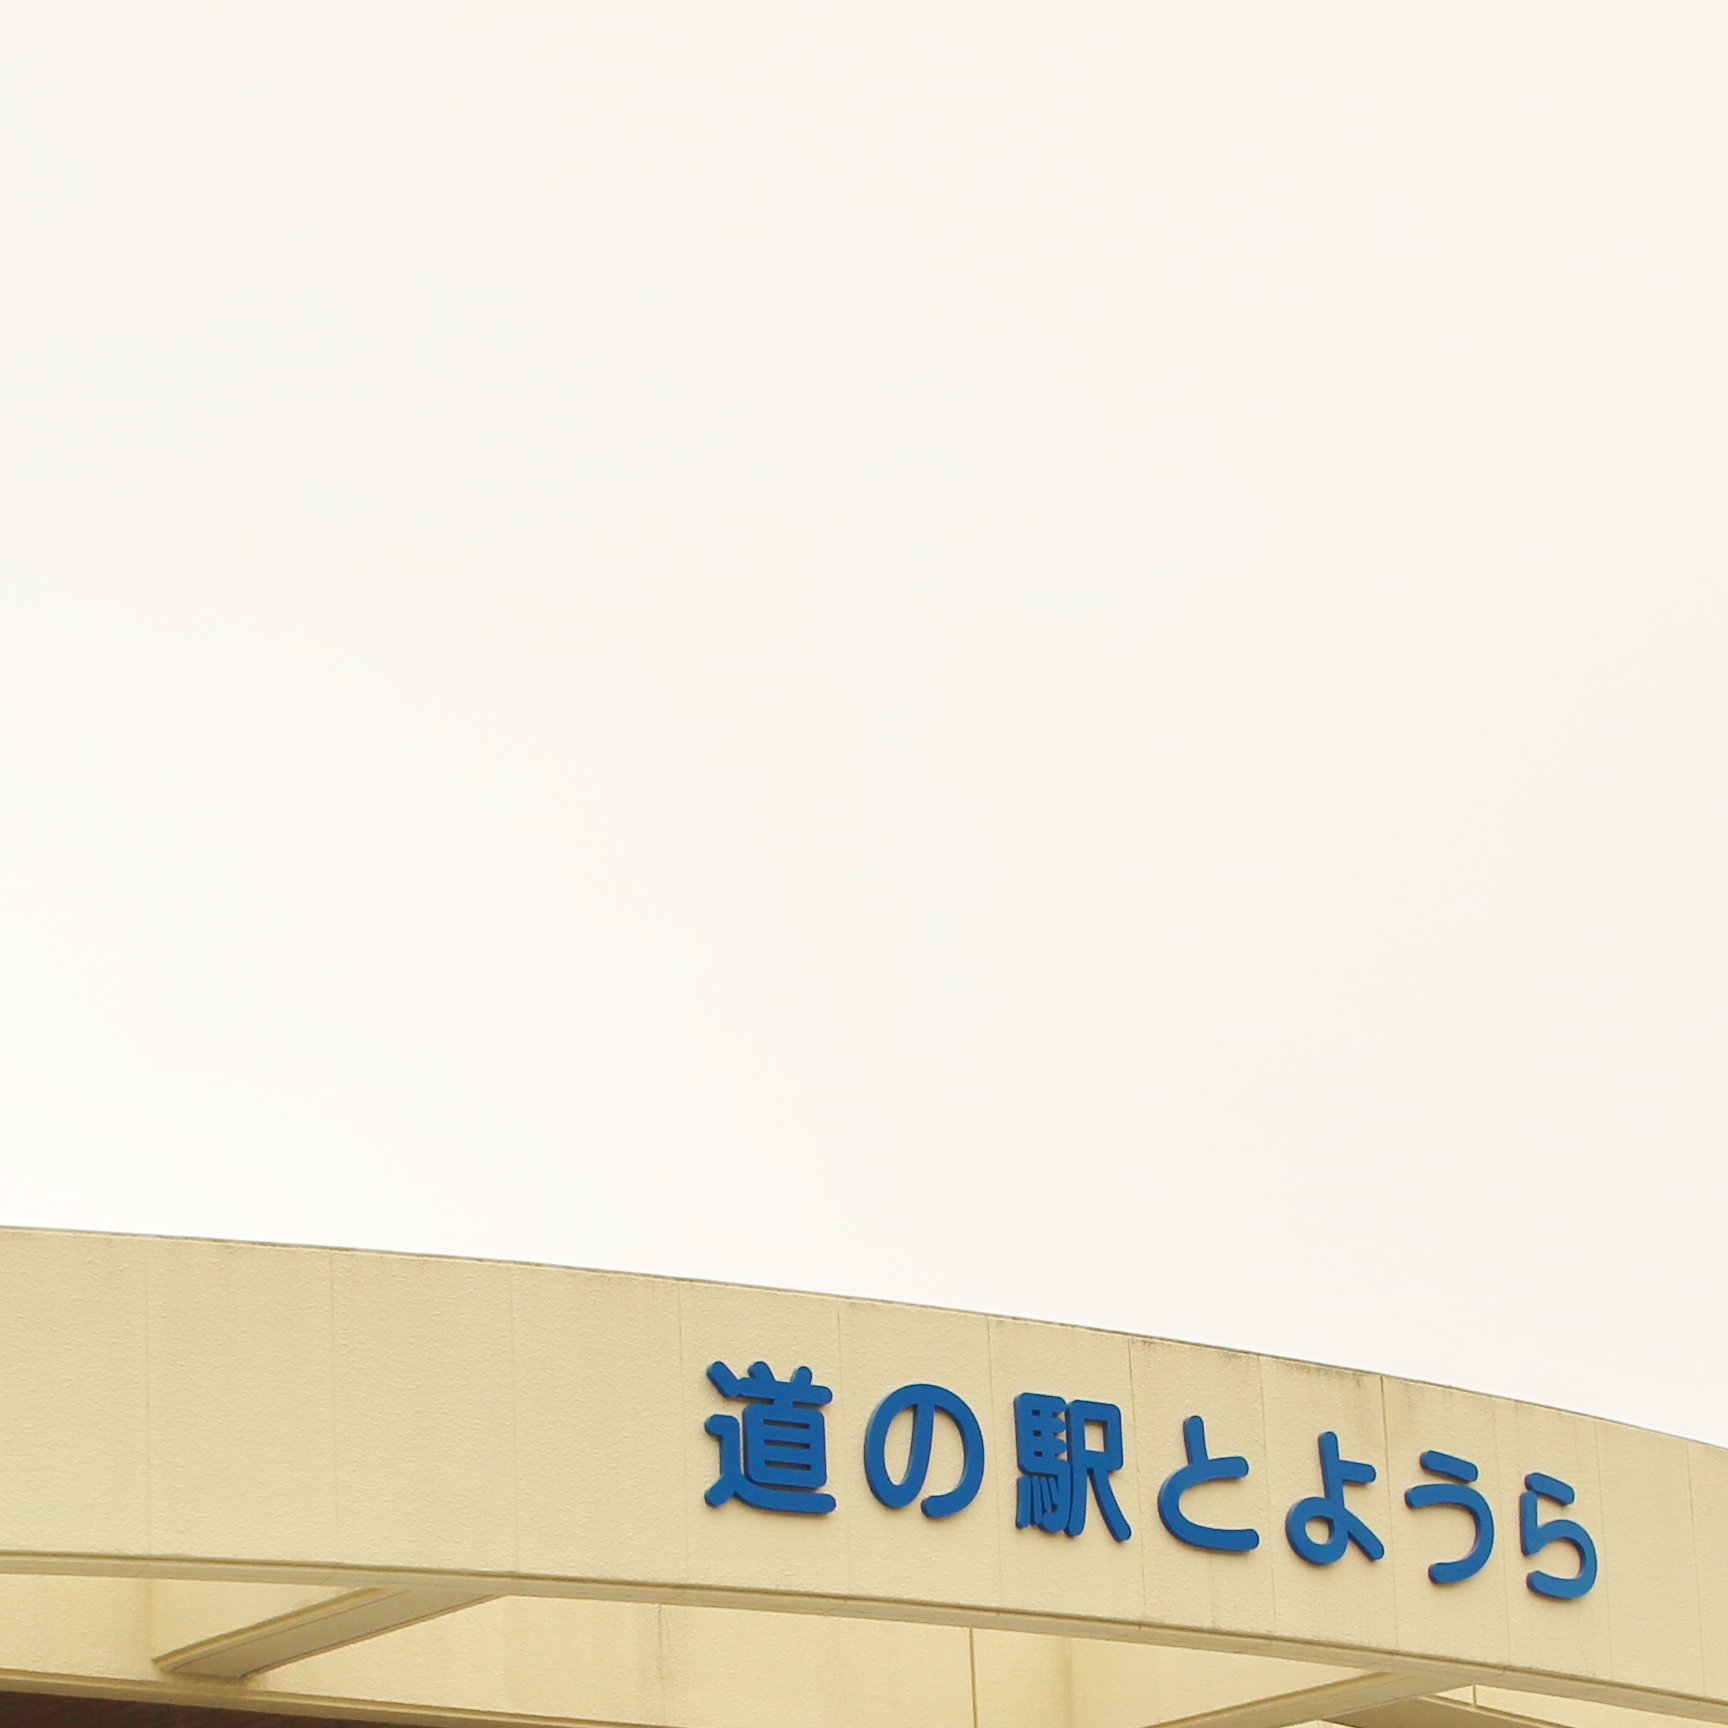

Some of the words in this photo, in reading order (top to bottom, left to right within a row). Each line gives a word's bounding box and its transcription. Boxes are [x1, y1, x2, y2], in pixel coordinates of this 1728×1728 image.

[703, 1360, 1598, 1600] 道の駅とようら
